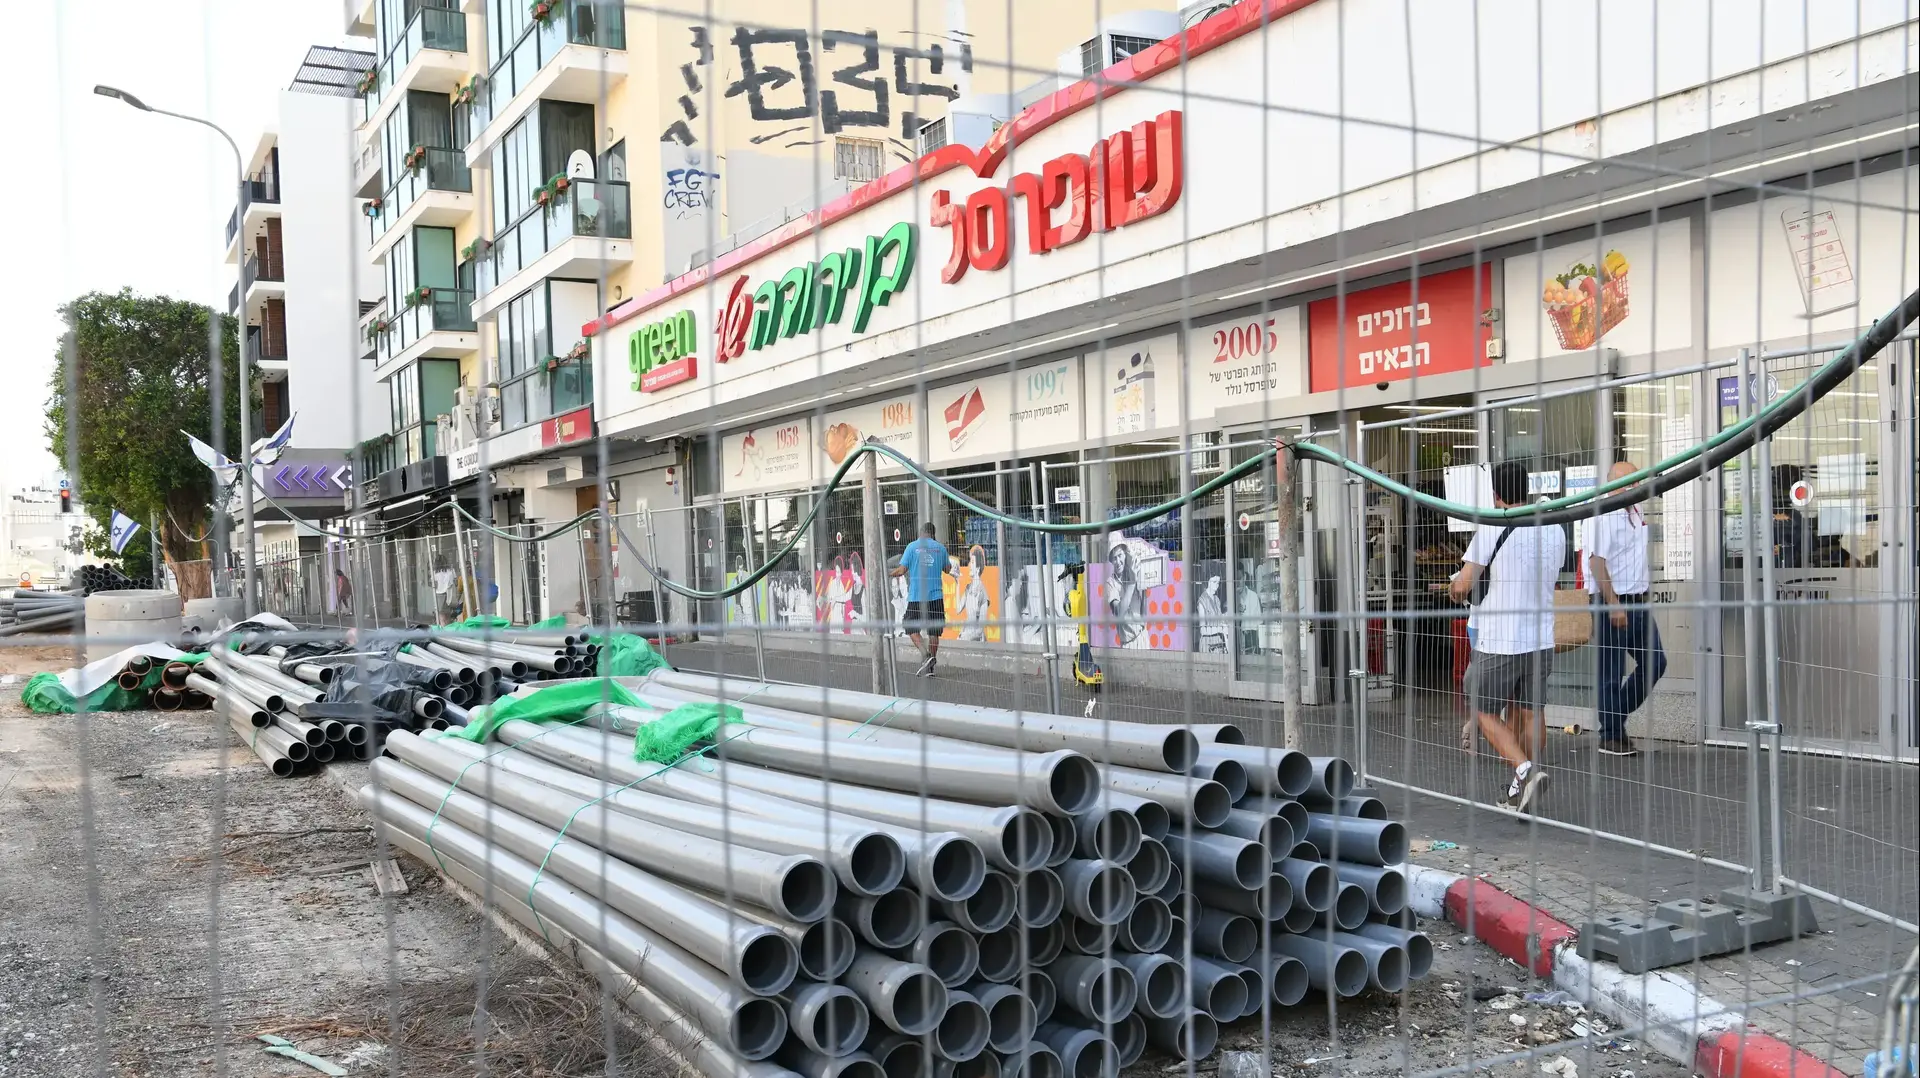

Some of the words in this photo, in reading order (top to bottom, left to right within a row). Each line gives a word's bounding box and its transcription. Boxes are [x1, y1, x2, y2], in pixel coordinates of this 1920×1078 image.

[664, 188, 716, 209] CREW
[930, 109, 1183, 285] שופרסל
[852, 221, 919, 334] בן
[748, 247, 863, 351] יהודה
[1357, 301, 1432, 338] ברוכים
[628, 309, 697, 392] green
[1212, 317, 1278, 363] 2005
[1358, 341, 1431, 375] הבאים
[1026, 366, 1068, 401] 1997
[1209, 371, 1221, 384] של
[1223, 367, 1249, 381] הפרטי
[1224, 383, 1242, 396] נולד
[1243, 379, 1277, 394] שופרסל
[882, 400, 912, 428] 1984
[1033, 406, 1053, 420] מועדון
[776, 425, 799, 450] 1958
